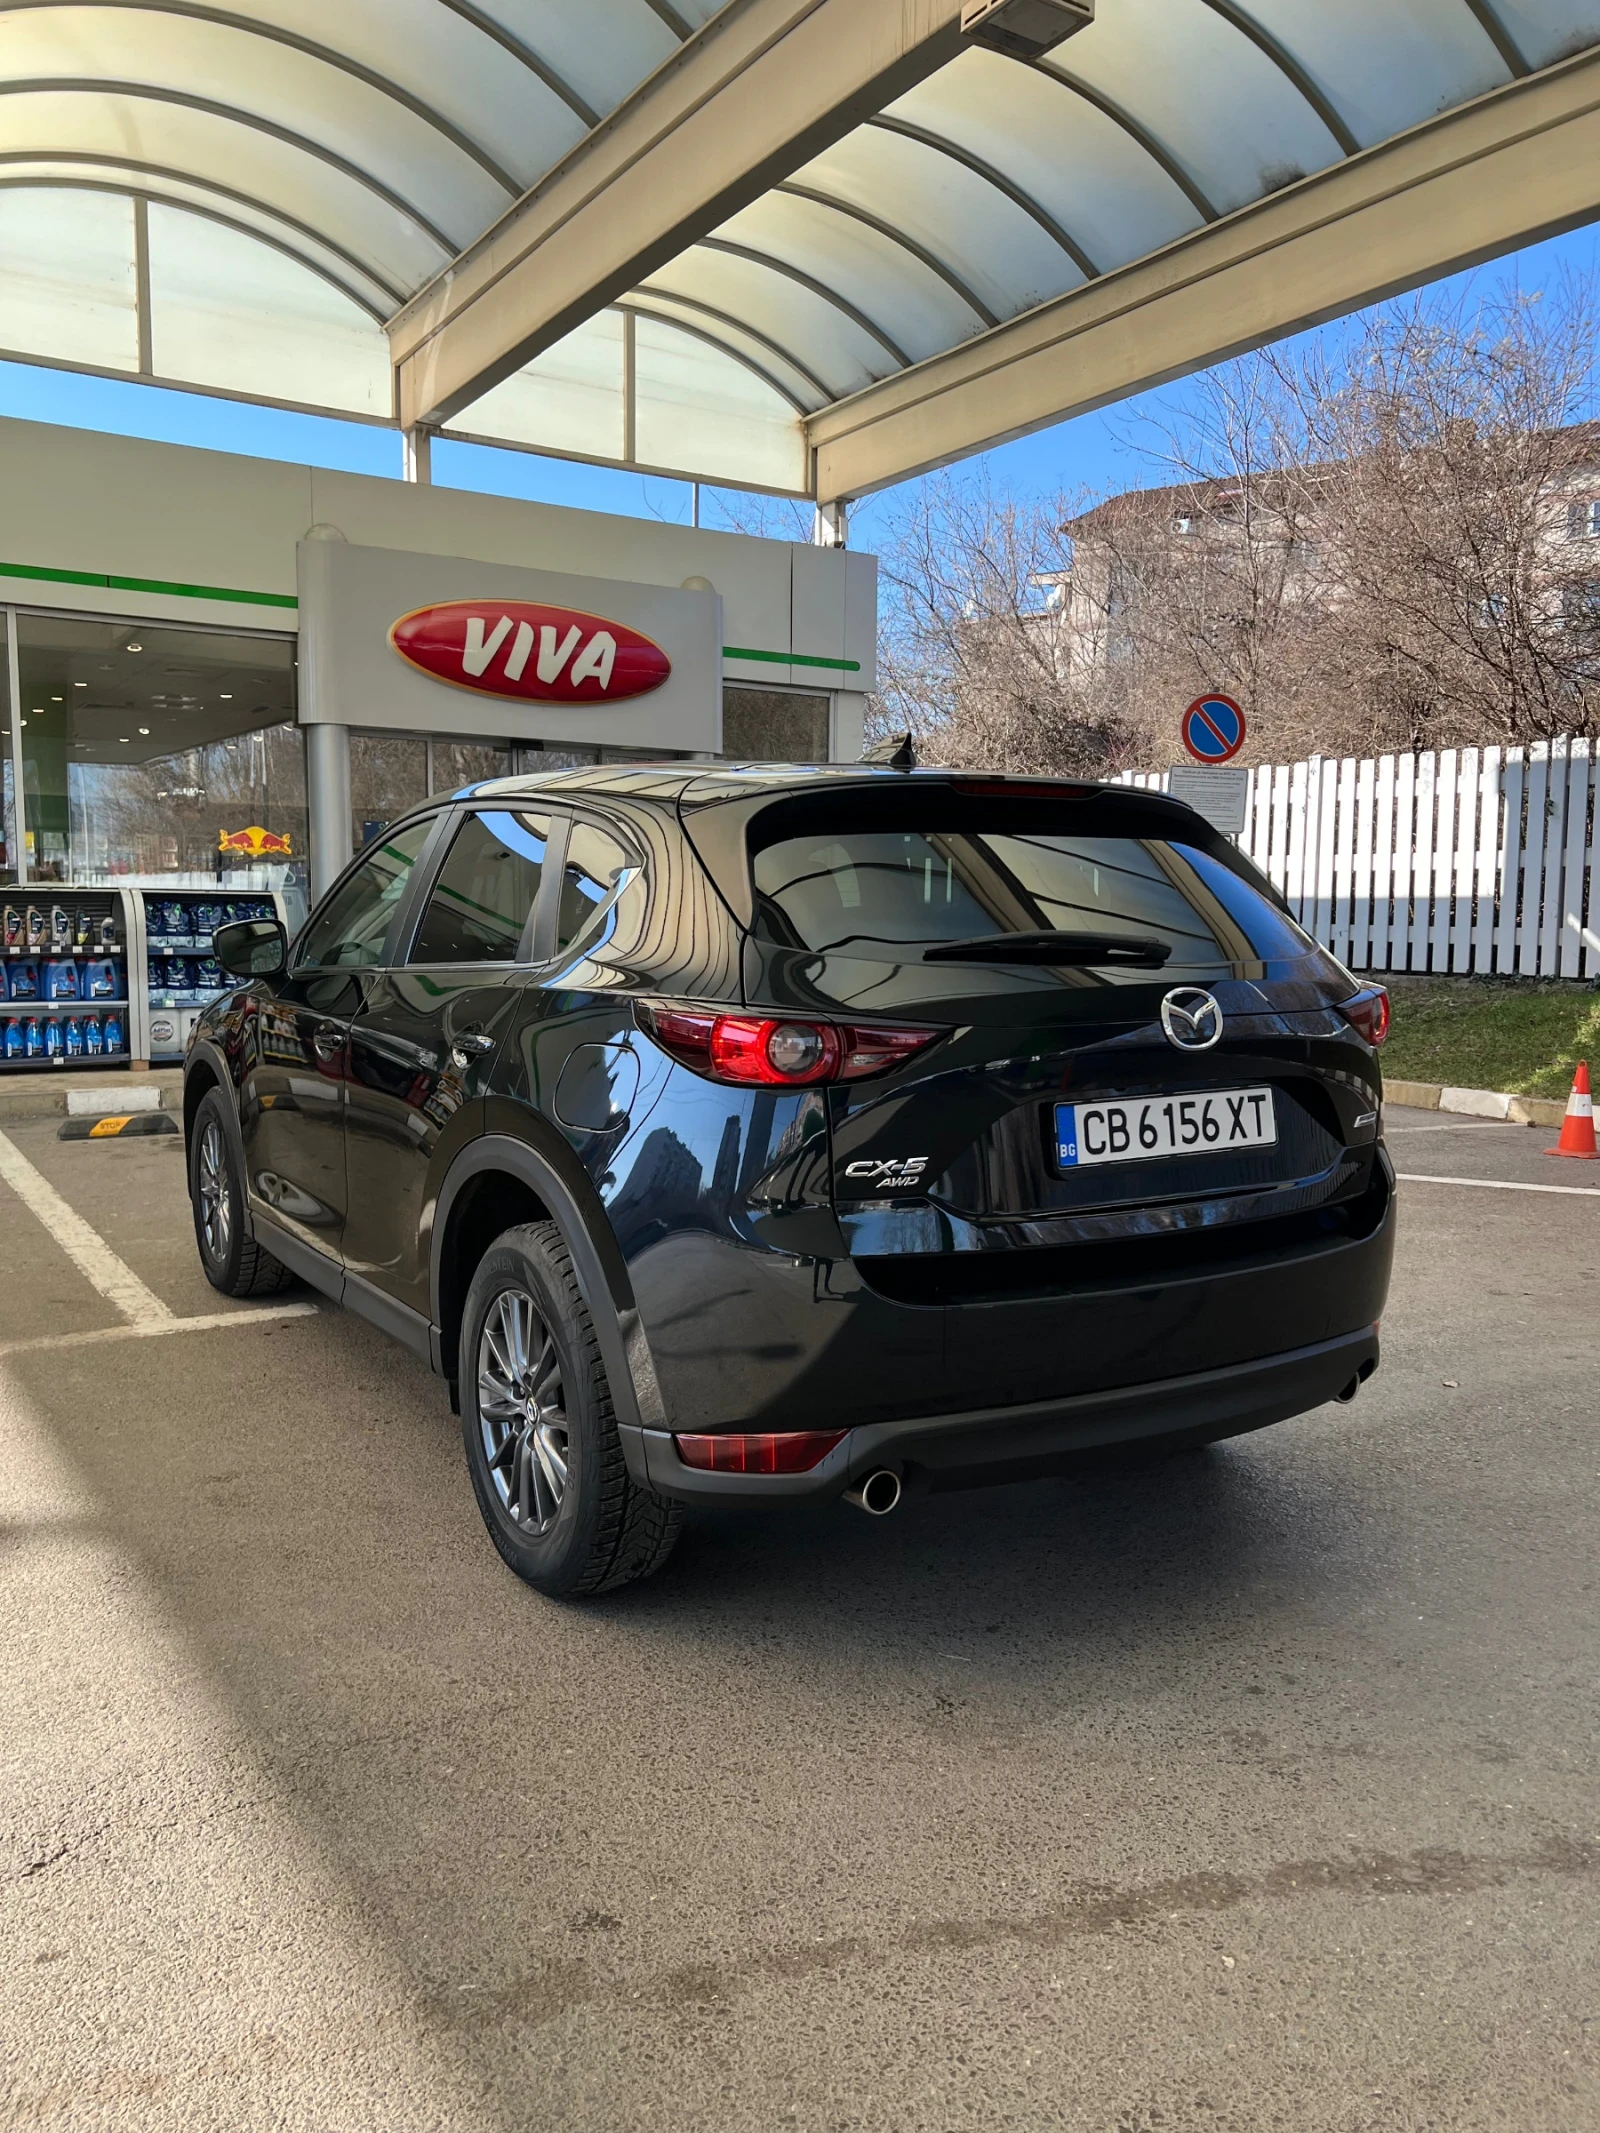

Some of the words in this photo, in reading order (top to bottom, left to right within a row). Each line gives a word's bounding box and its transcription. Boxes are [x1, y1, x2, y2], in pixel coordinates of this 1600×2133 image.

[462, 614, 617, 690] VIVA
[1083, 1107, 1131, 1155] CB
[1138, 1098, 1220, 1149] 6156
[1226, 1094, 1267, 1140] XT
[1059, 1143, 1076, 1158] BG
[845, 1157, 929, 1177] CX-5
[875, 1176, 919, 1188] AWD
